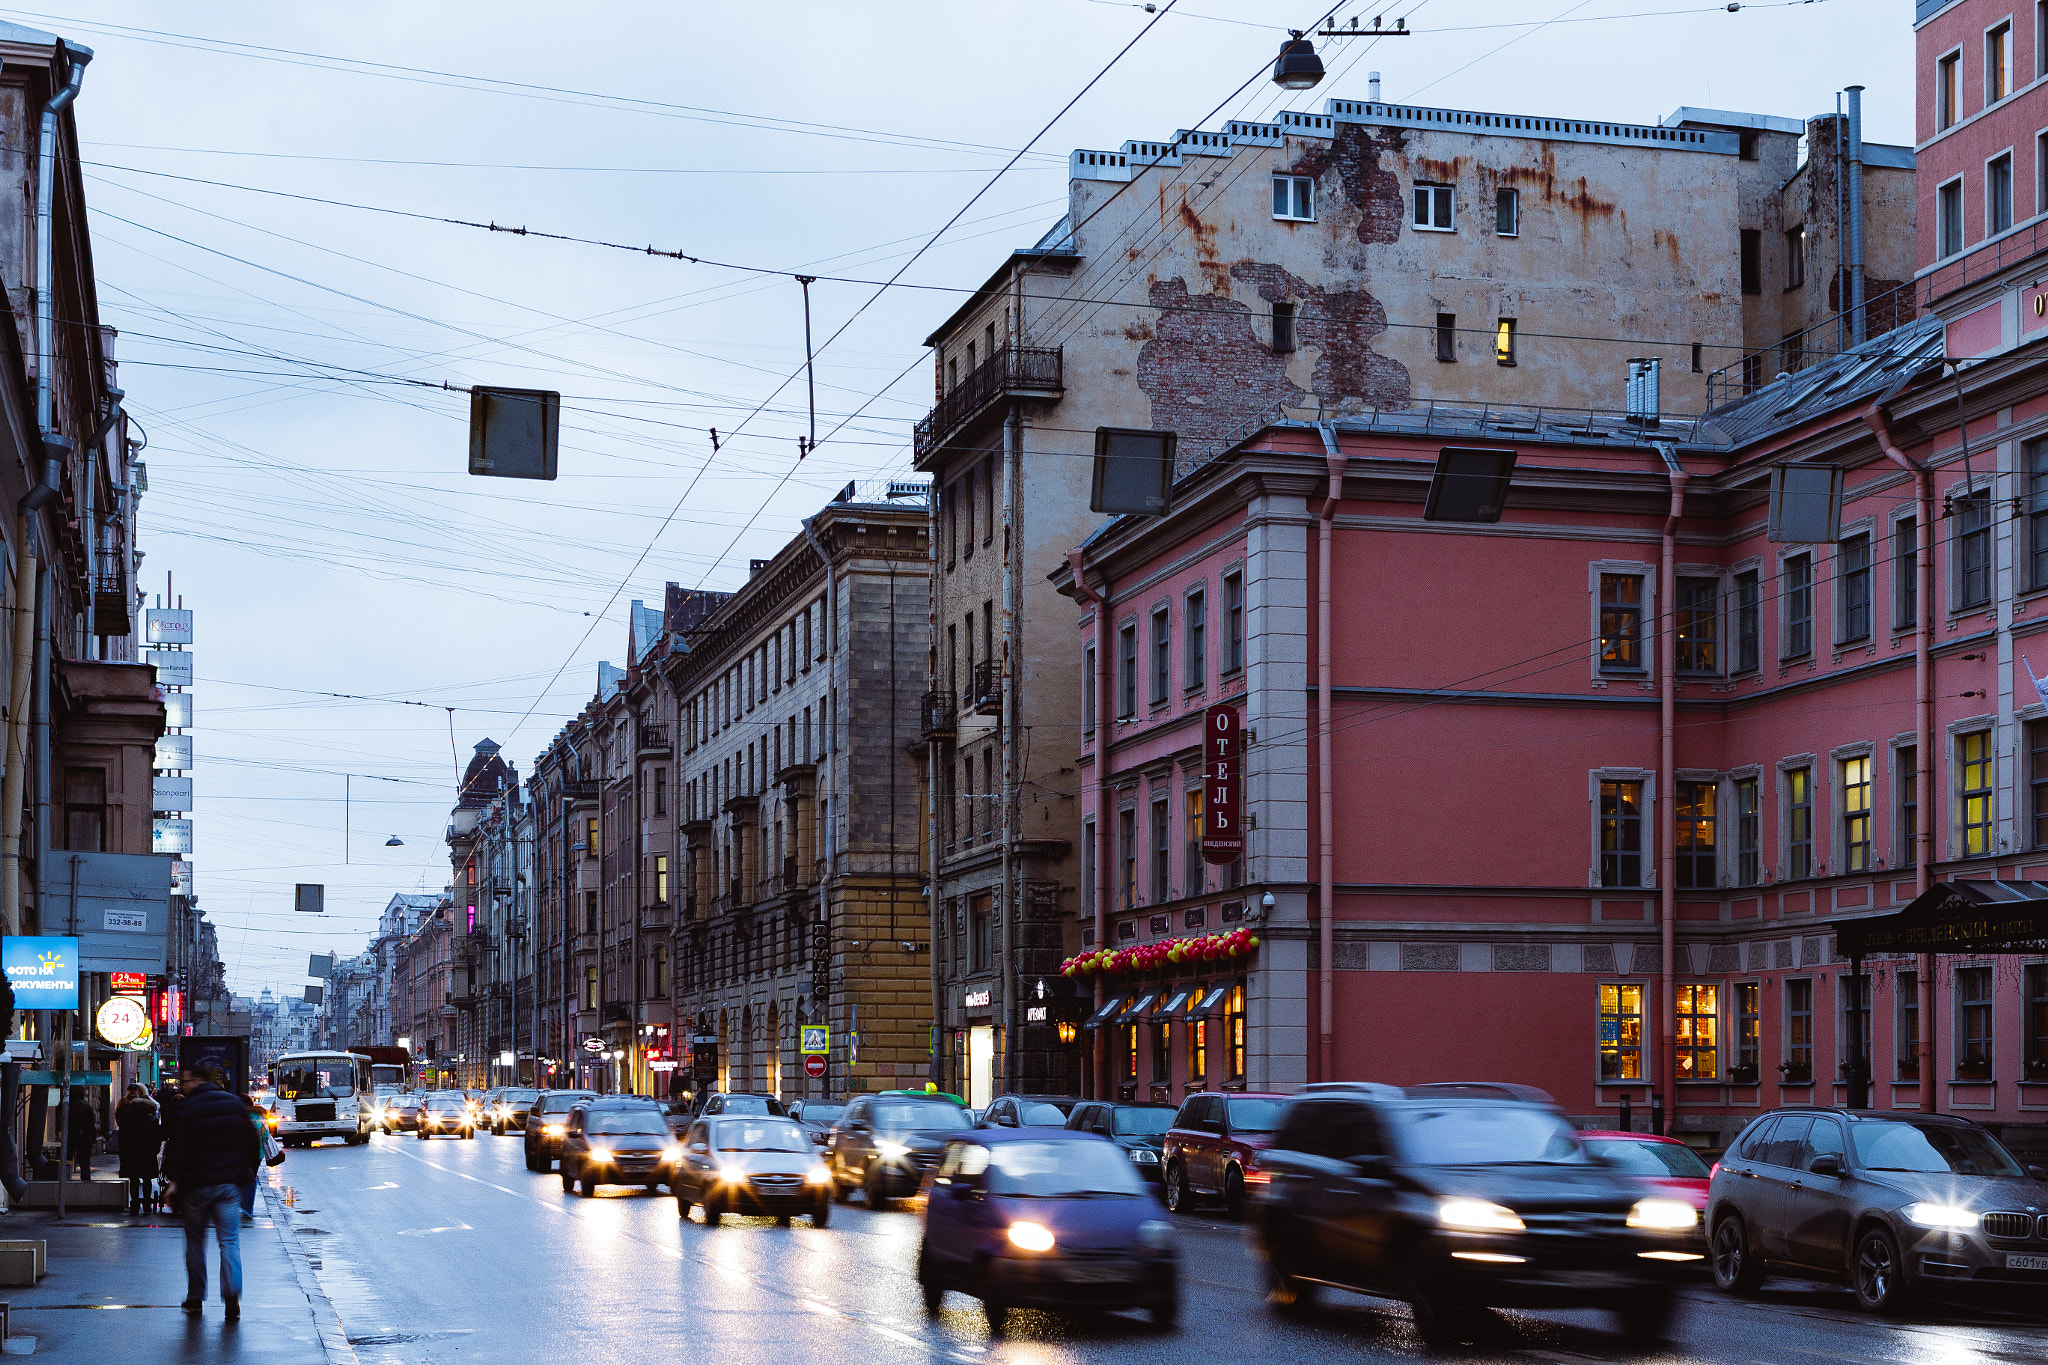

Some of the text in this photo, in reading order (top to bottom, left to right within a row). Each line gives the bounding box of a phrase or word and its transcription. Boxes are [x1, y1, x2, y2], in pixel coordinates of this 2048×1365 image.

[1213, 713, 1229, 829] ОТЕЛЬ
[153, 790, 190, 800] asonpearl
[1203, 839, 1242, 848] ВВЕДЕНСКИЙ
[108, 918, 143, 927] 332-98-88
[1904, 917, 1988, 945] ВВЕДЕНСКИЙ
[2001, 919, 2036, 936] HOTEL
[813, 924, 829, 996] DOMINO
[7, 966, 54, 976] ФОТО НА
[9, 980, 74, 991] ДОКУМЕНТЫ
[111, 1013, 130, 1024] 24
[284, 1090, 298, 1099] 127
